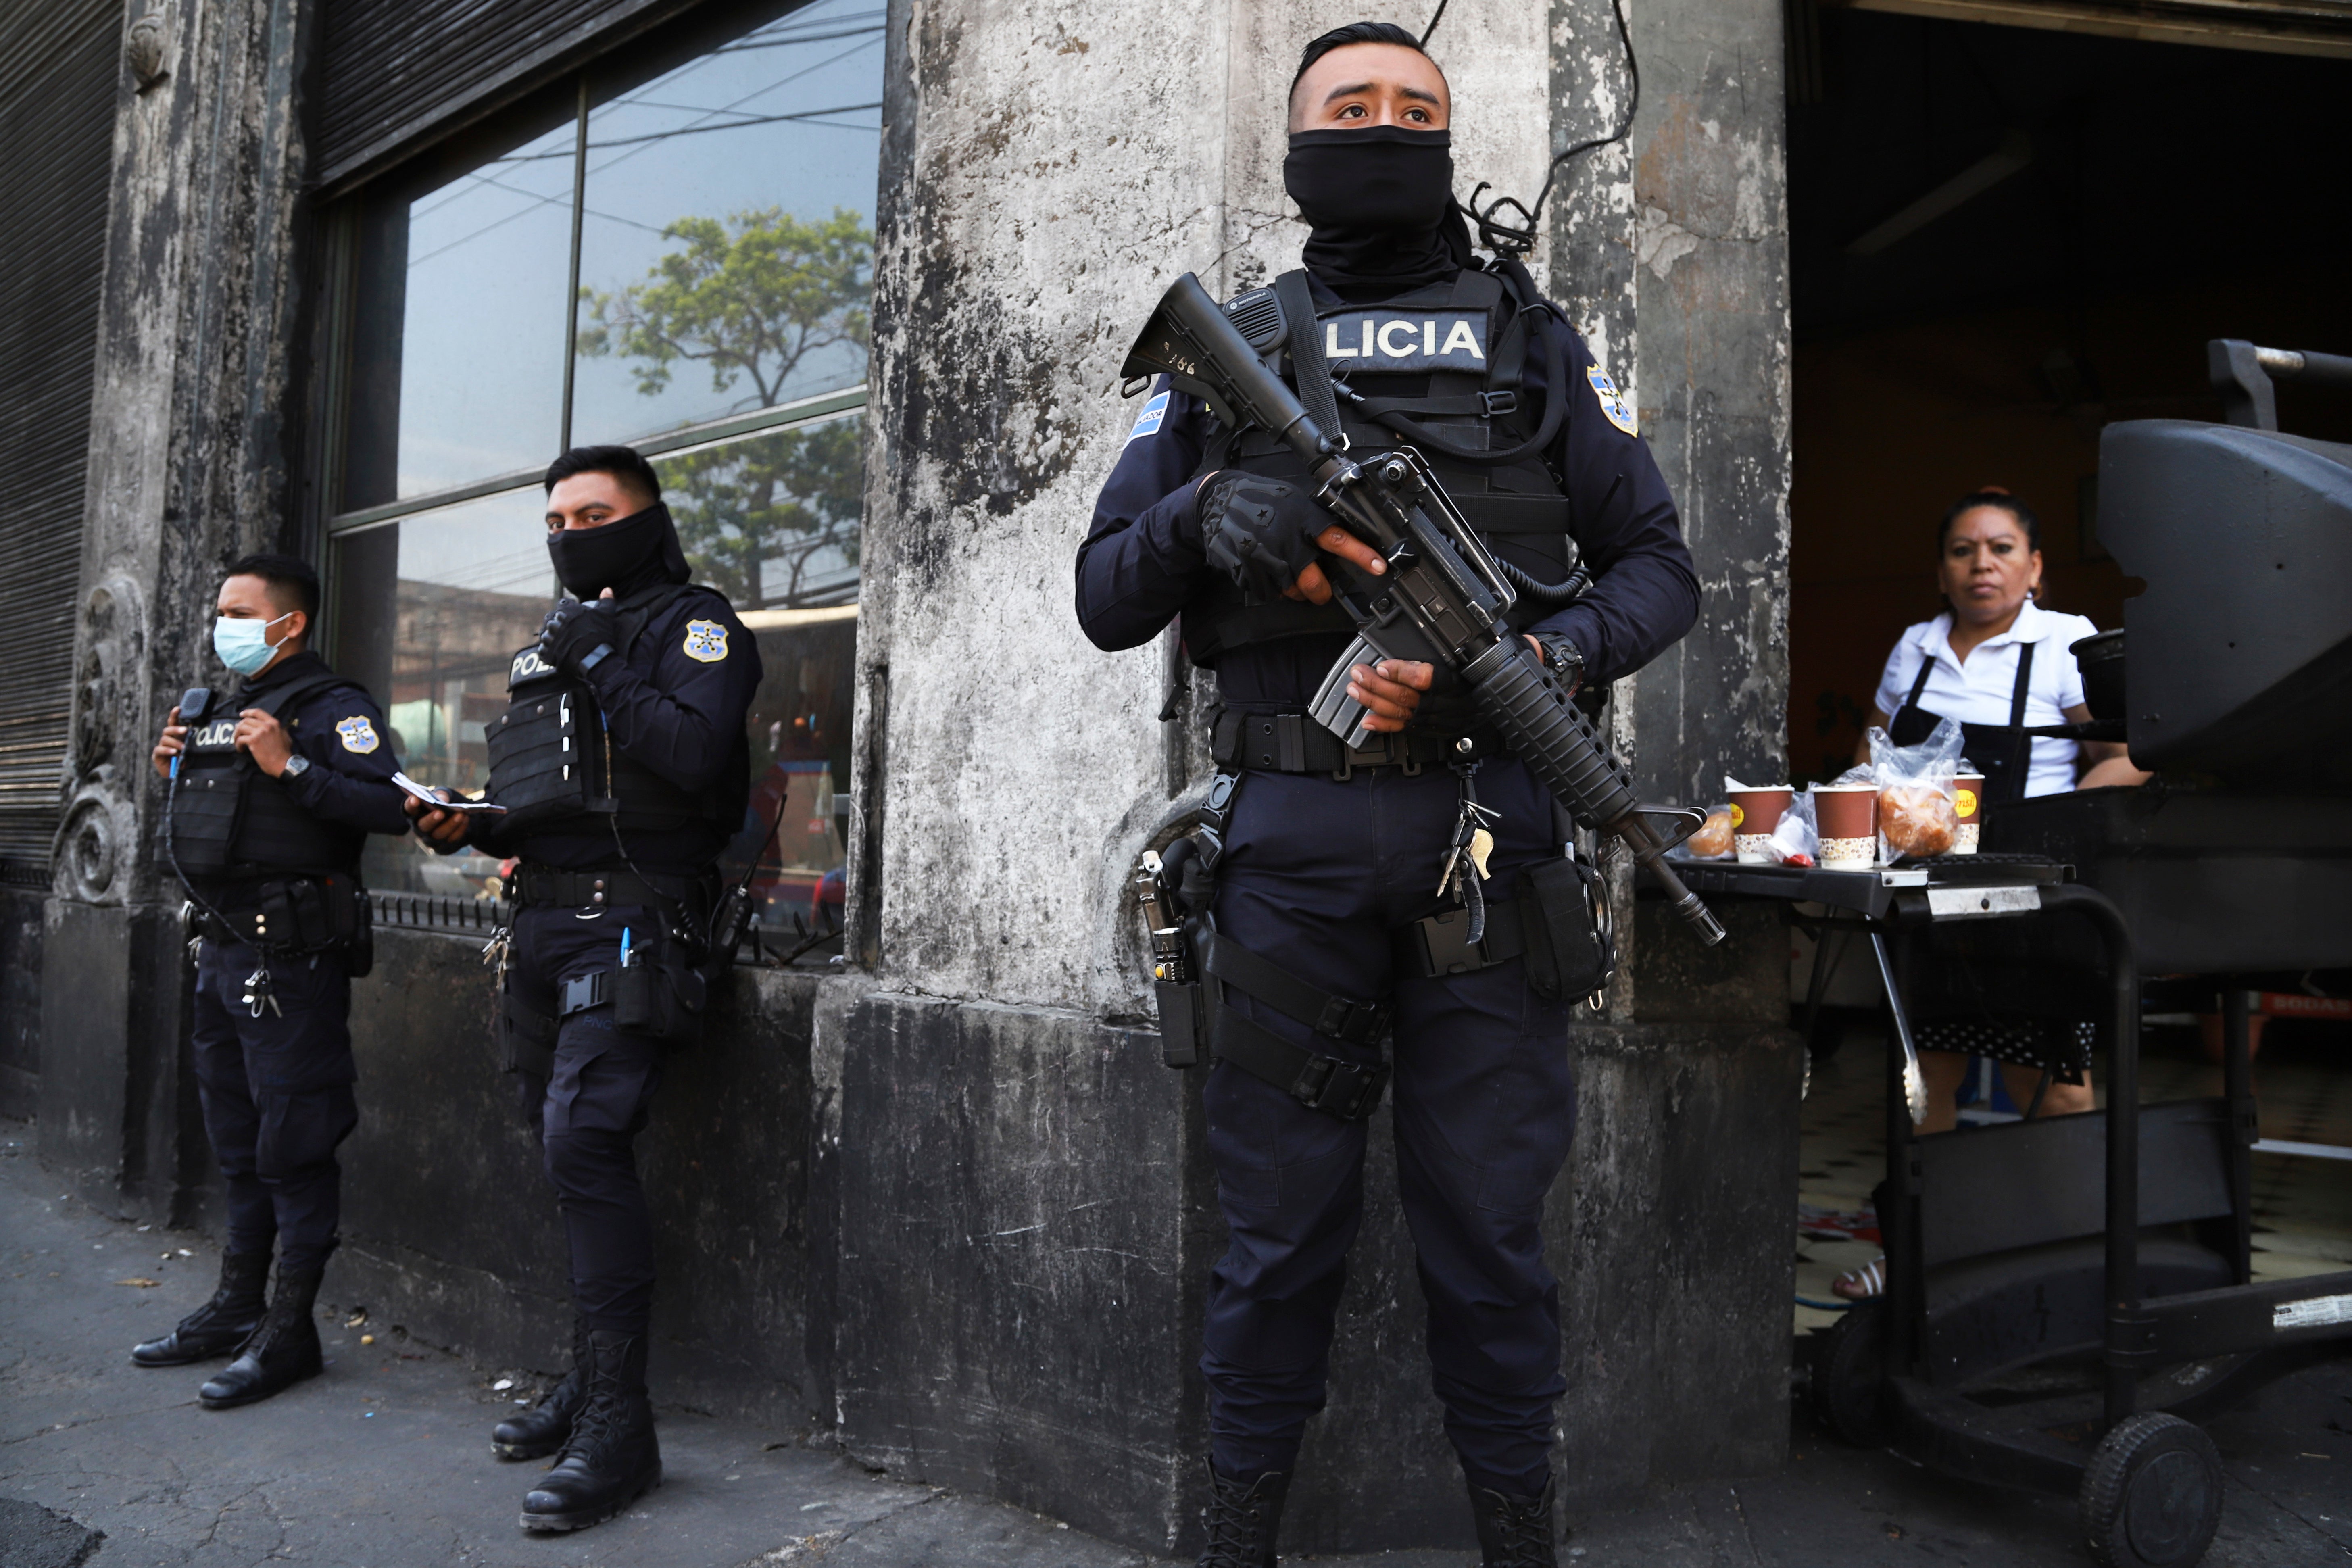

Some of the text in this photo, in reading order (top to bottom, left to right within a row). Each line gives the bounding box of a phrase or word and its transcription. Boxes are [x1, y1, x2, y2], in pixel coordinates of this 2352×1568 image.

[1239, 292, 1266, 305] MOTOROLA
[1326, 319, 1485, 359] LICIA
[510, 652, 554, 682] POL
[583, 1015, 613, 1030] PNC
